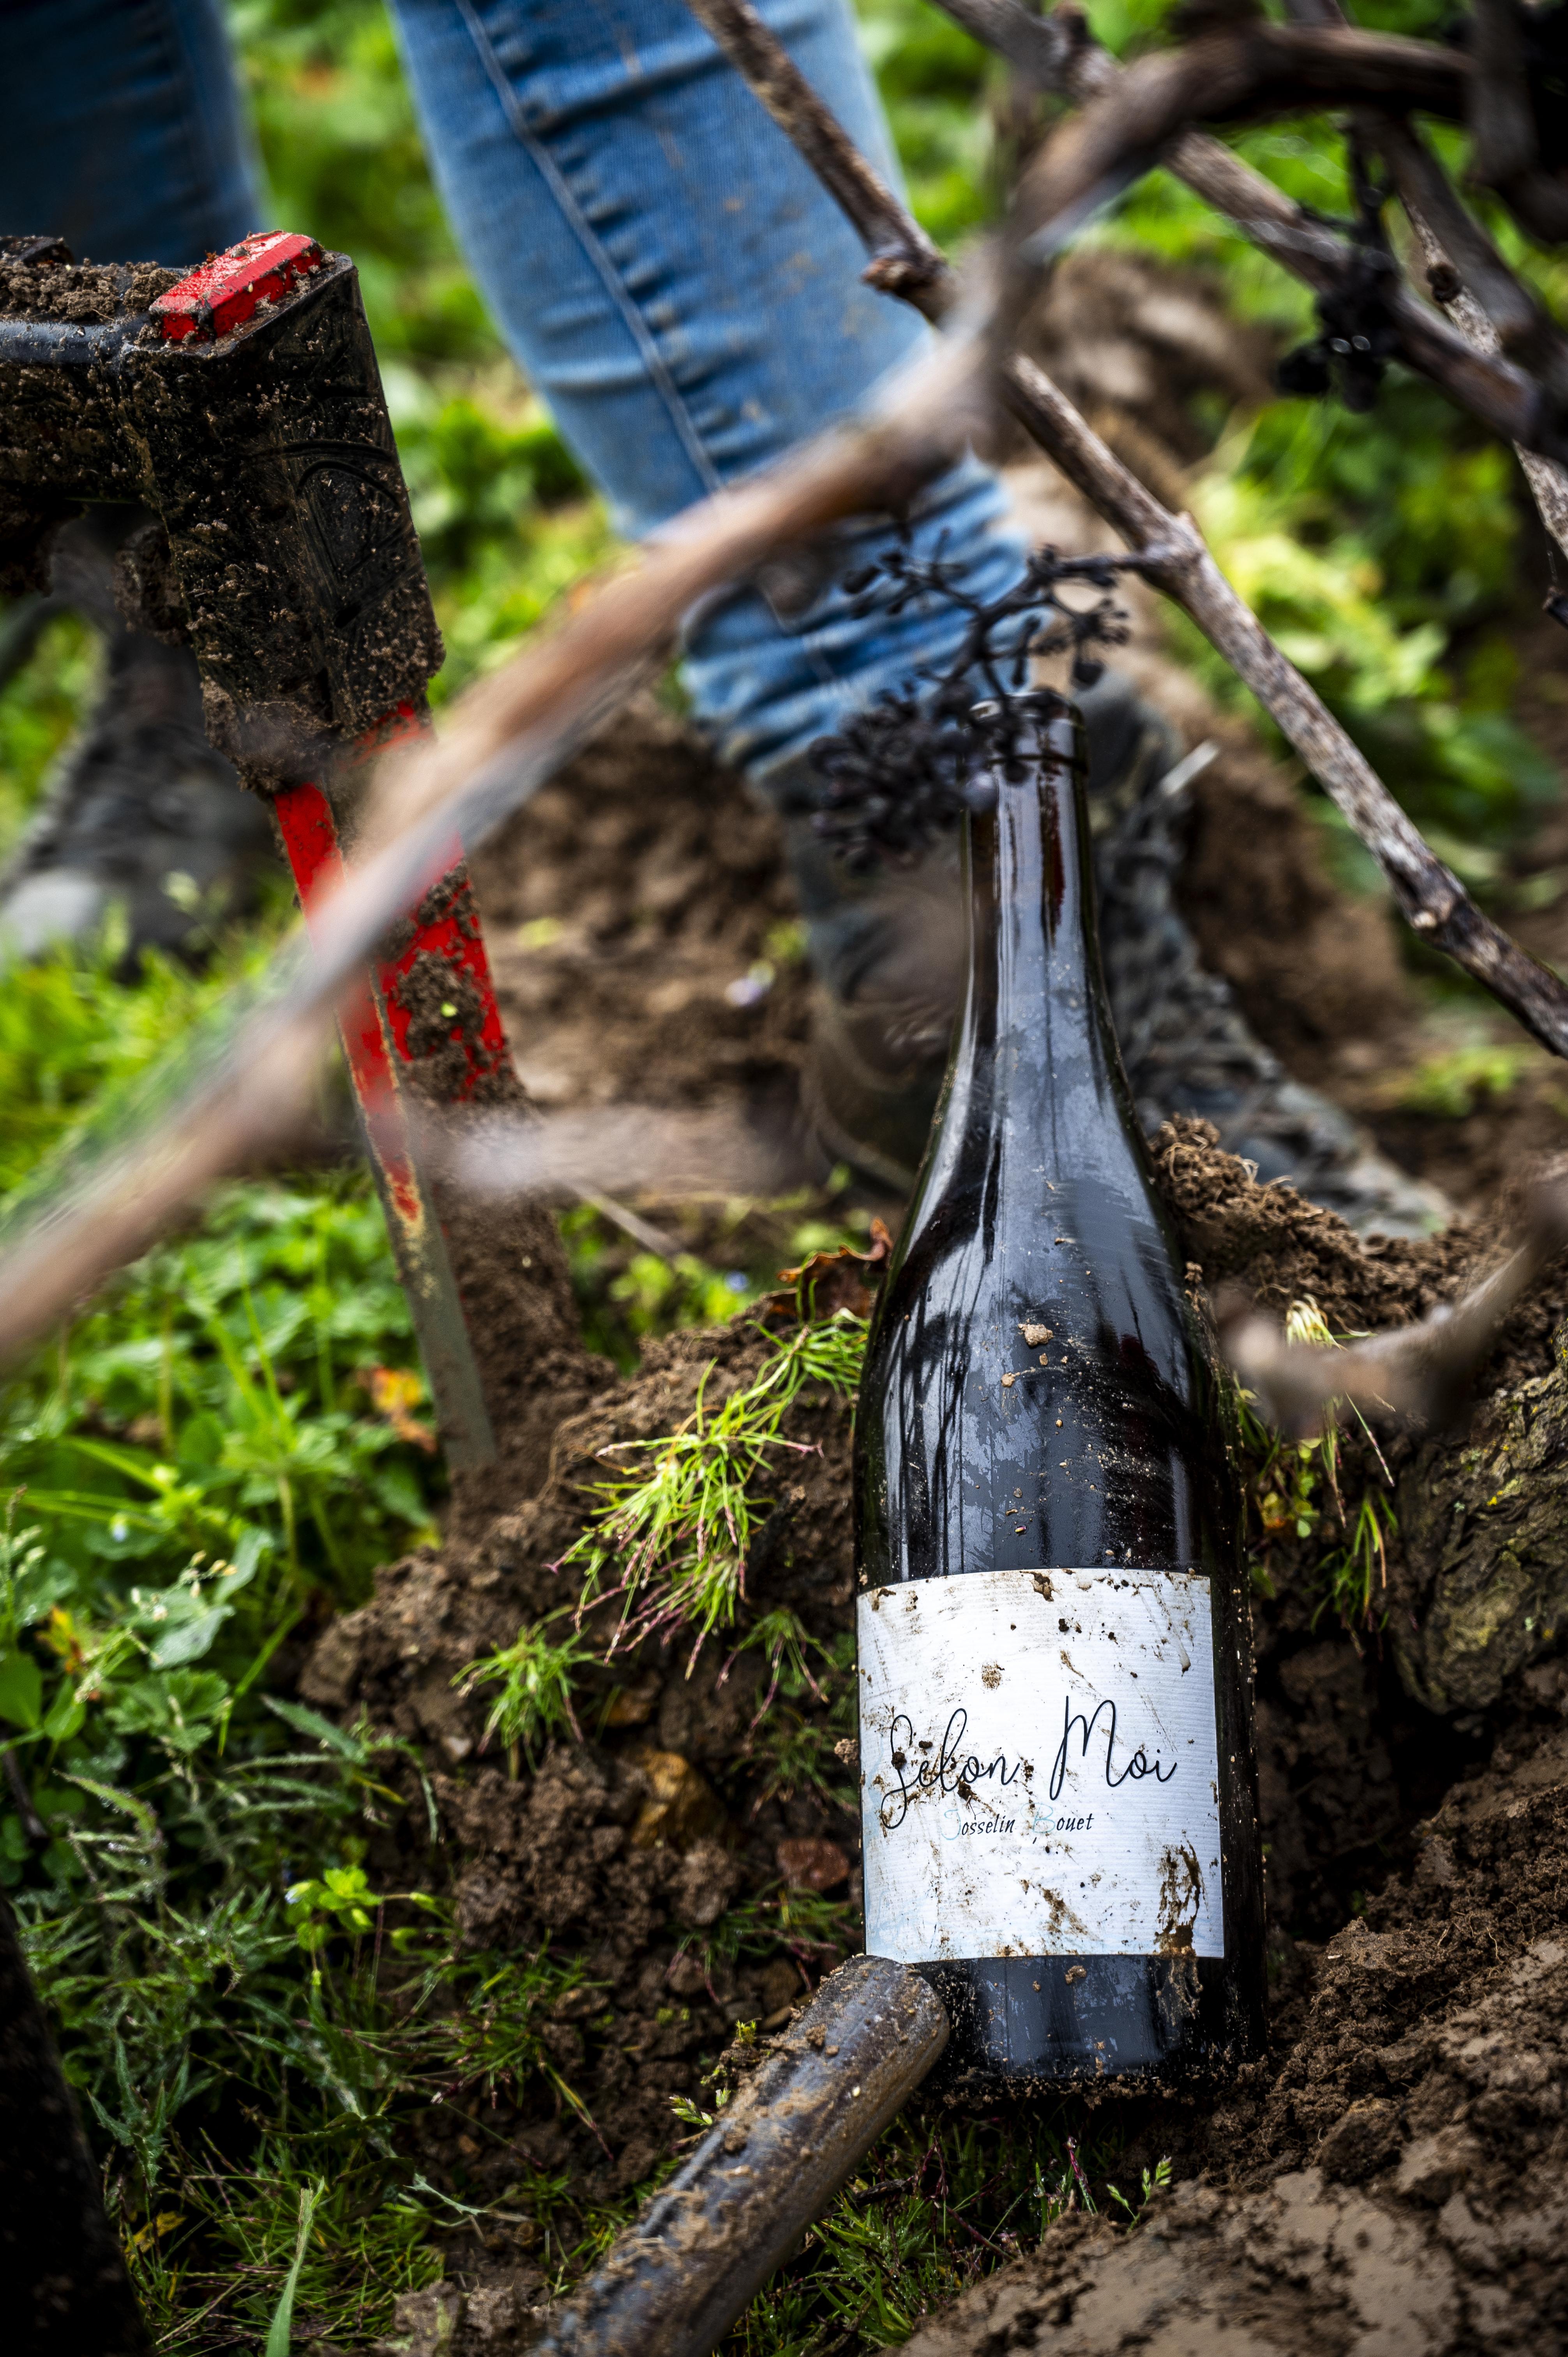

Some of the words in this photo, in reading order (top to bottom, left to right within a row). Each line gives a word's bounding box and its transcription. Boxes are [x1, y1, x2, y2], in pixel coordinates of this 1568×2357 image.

[881, 1708, 1020, 1829] Selon
[1049, 1695, 1177, 1800] Moi
[941, 1809, 1015, 1841] Josselin
[1020, 1802, 1095, 1834] Bouet
